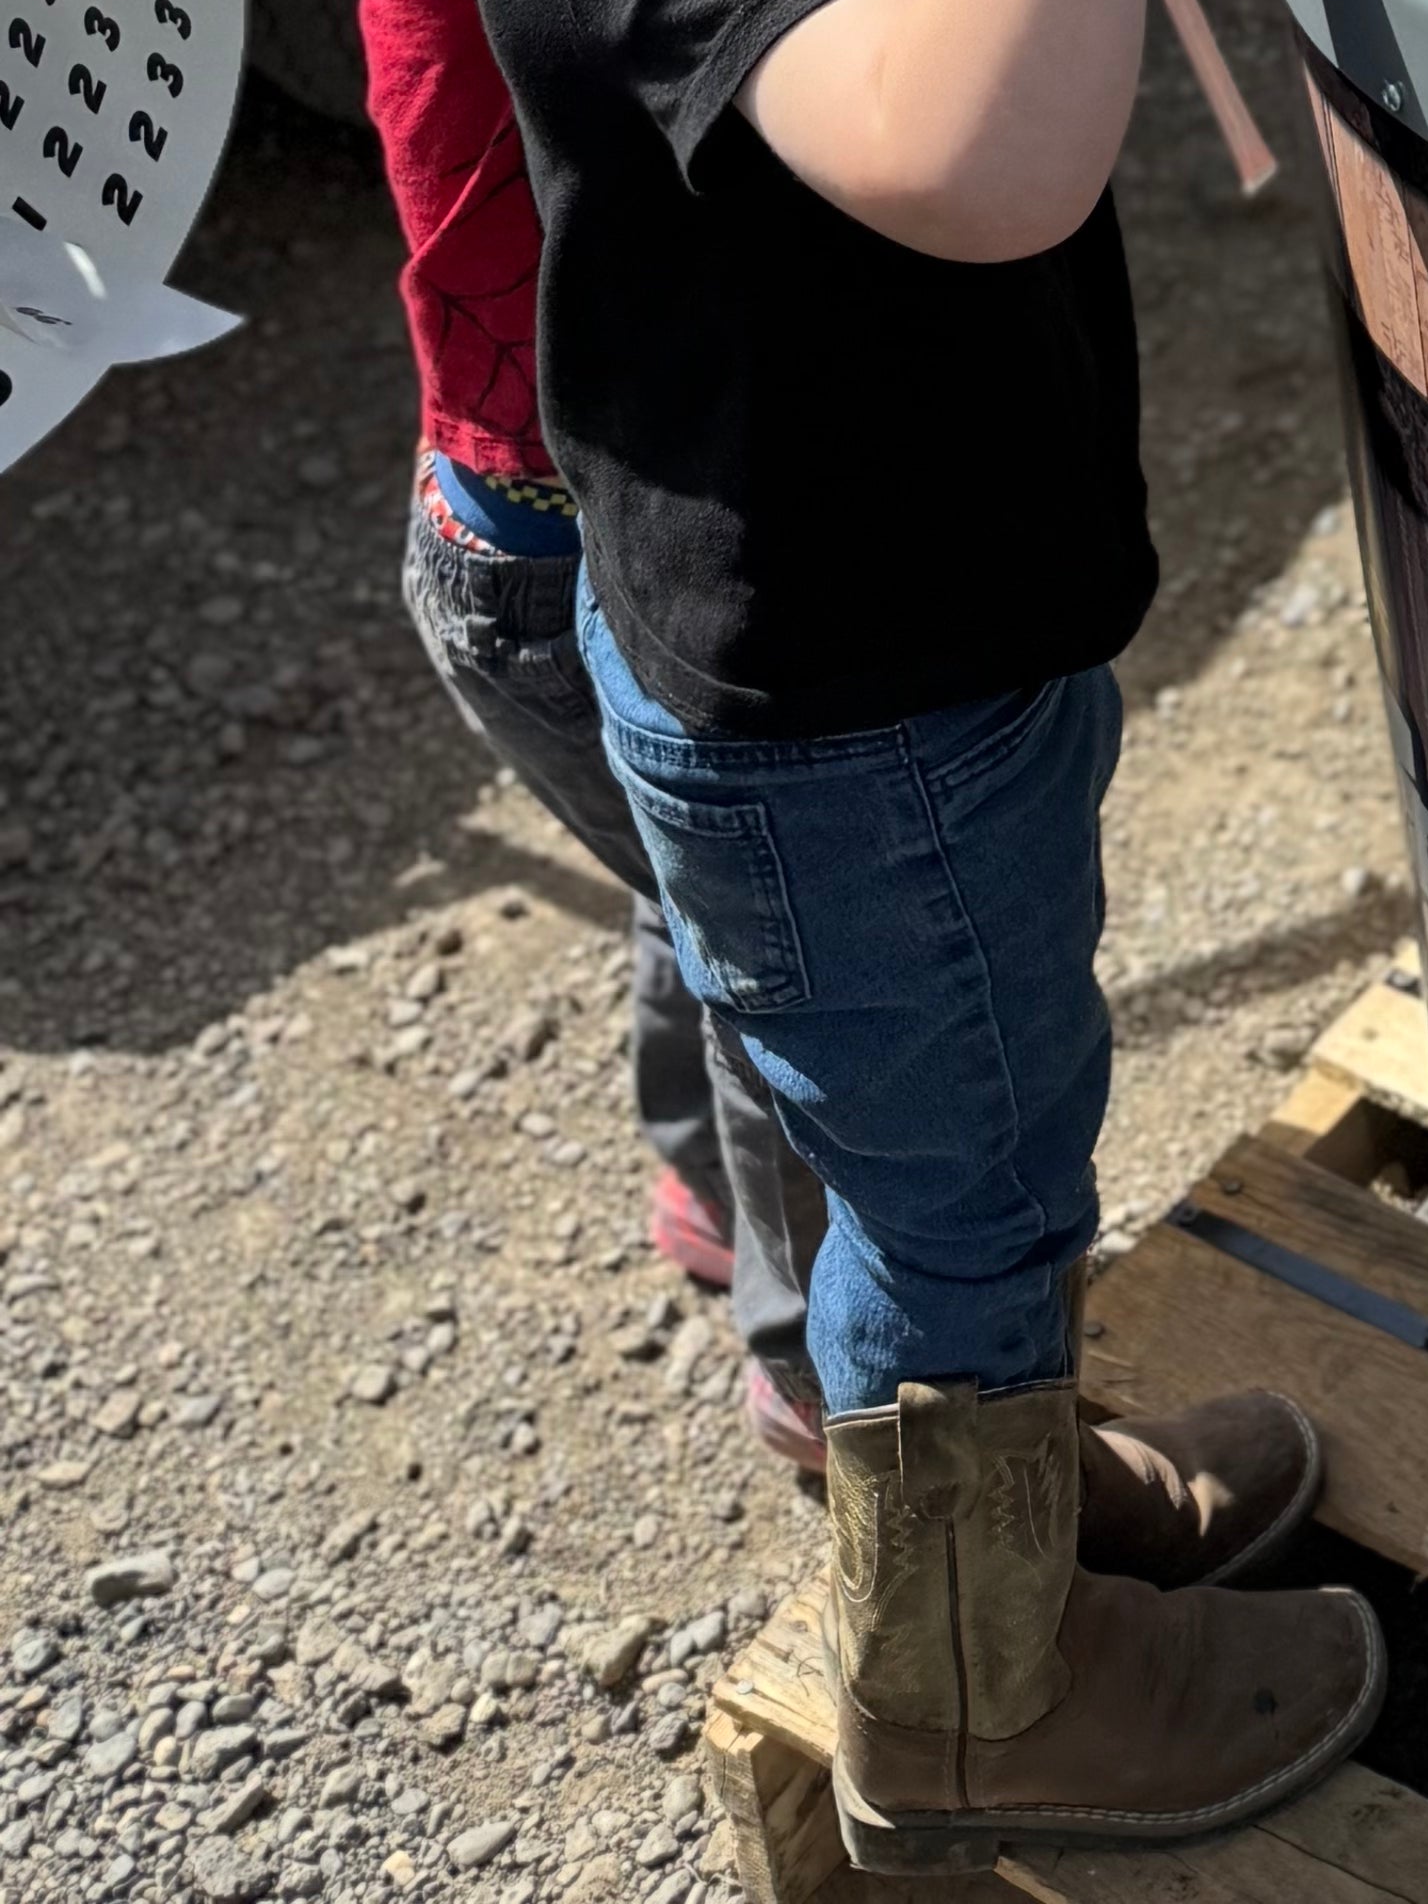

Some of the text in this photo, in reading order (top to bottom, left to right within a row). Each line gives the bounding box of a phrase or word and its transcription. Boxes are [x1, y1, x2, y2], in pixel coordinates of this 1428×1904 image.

[9, 18, 46, 68] 2
[84, 6, 121, 53] 3
[68, 64, 107, 115] 2
[147, 52, 184, 99] 3
[43, 126, 84, 178] 2
[129, 111, 168, 162] 2
[102, 173, 144, 226] 2
